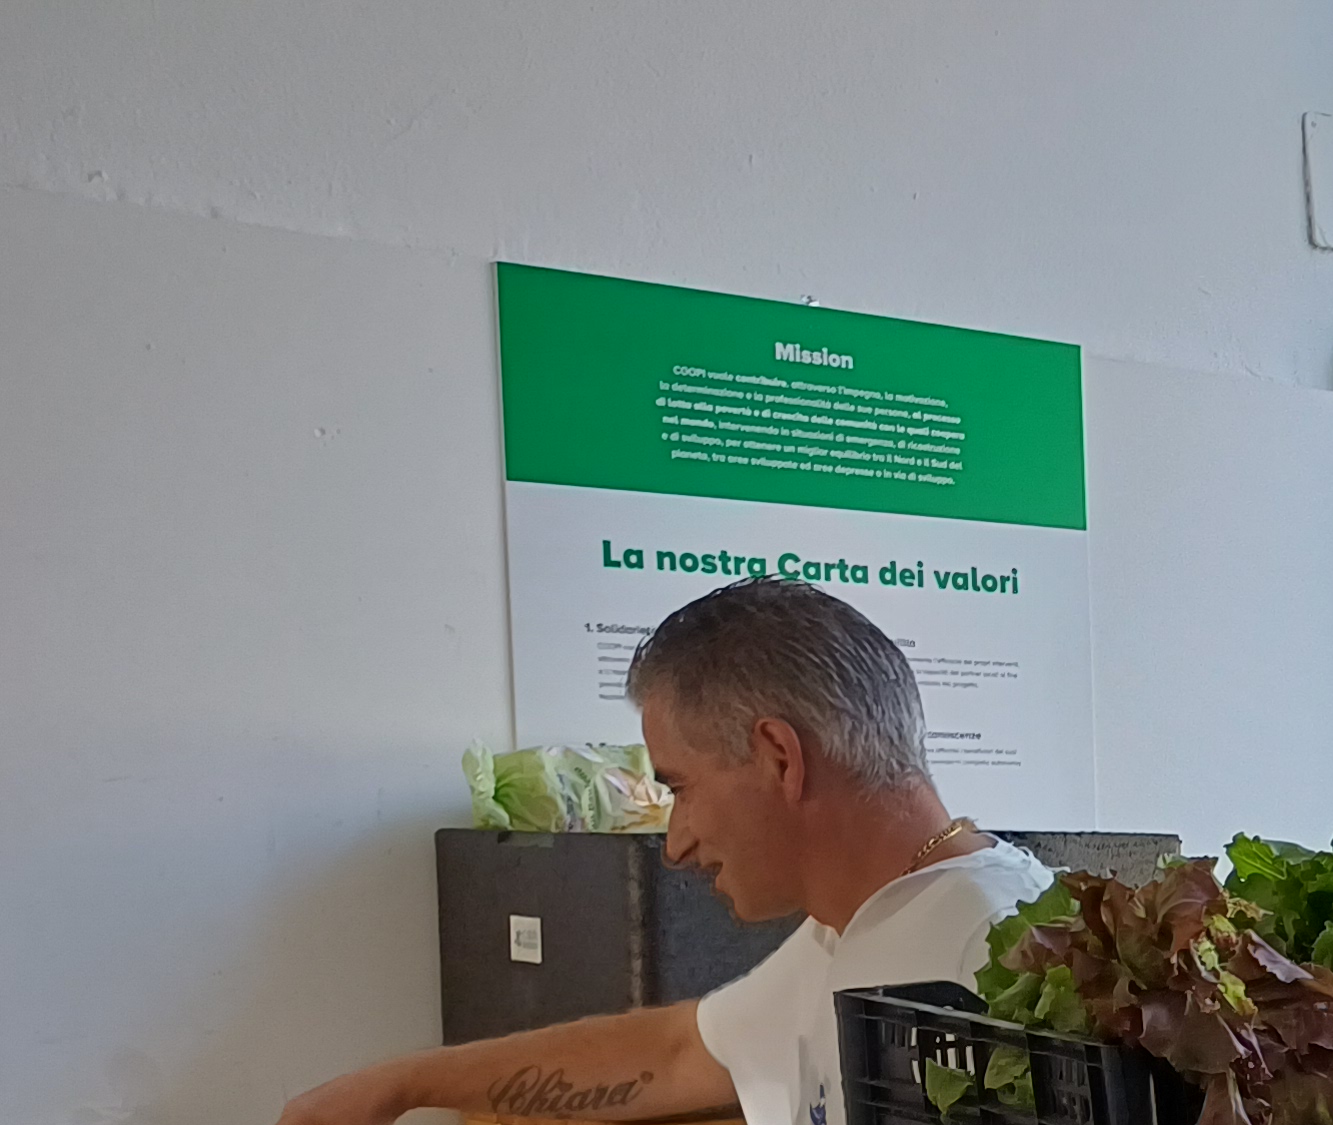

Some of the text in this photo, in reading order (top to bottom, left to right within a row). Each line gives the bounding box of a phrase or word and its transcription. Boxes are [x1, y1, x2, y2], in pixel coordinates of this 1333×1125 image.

[774, 341, 855, 370] Mission
[601, 539, 1020, 596] La nostra Carta dei valori
[596, 622, 657, 636] Solidariet
[486, 1063, 641, 1116] Chiara
